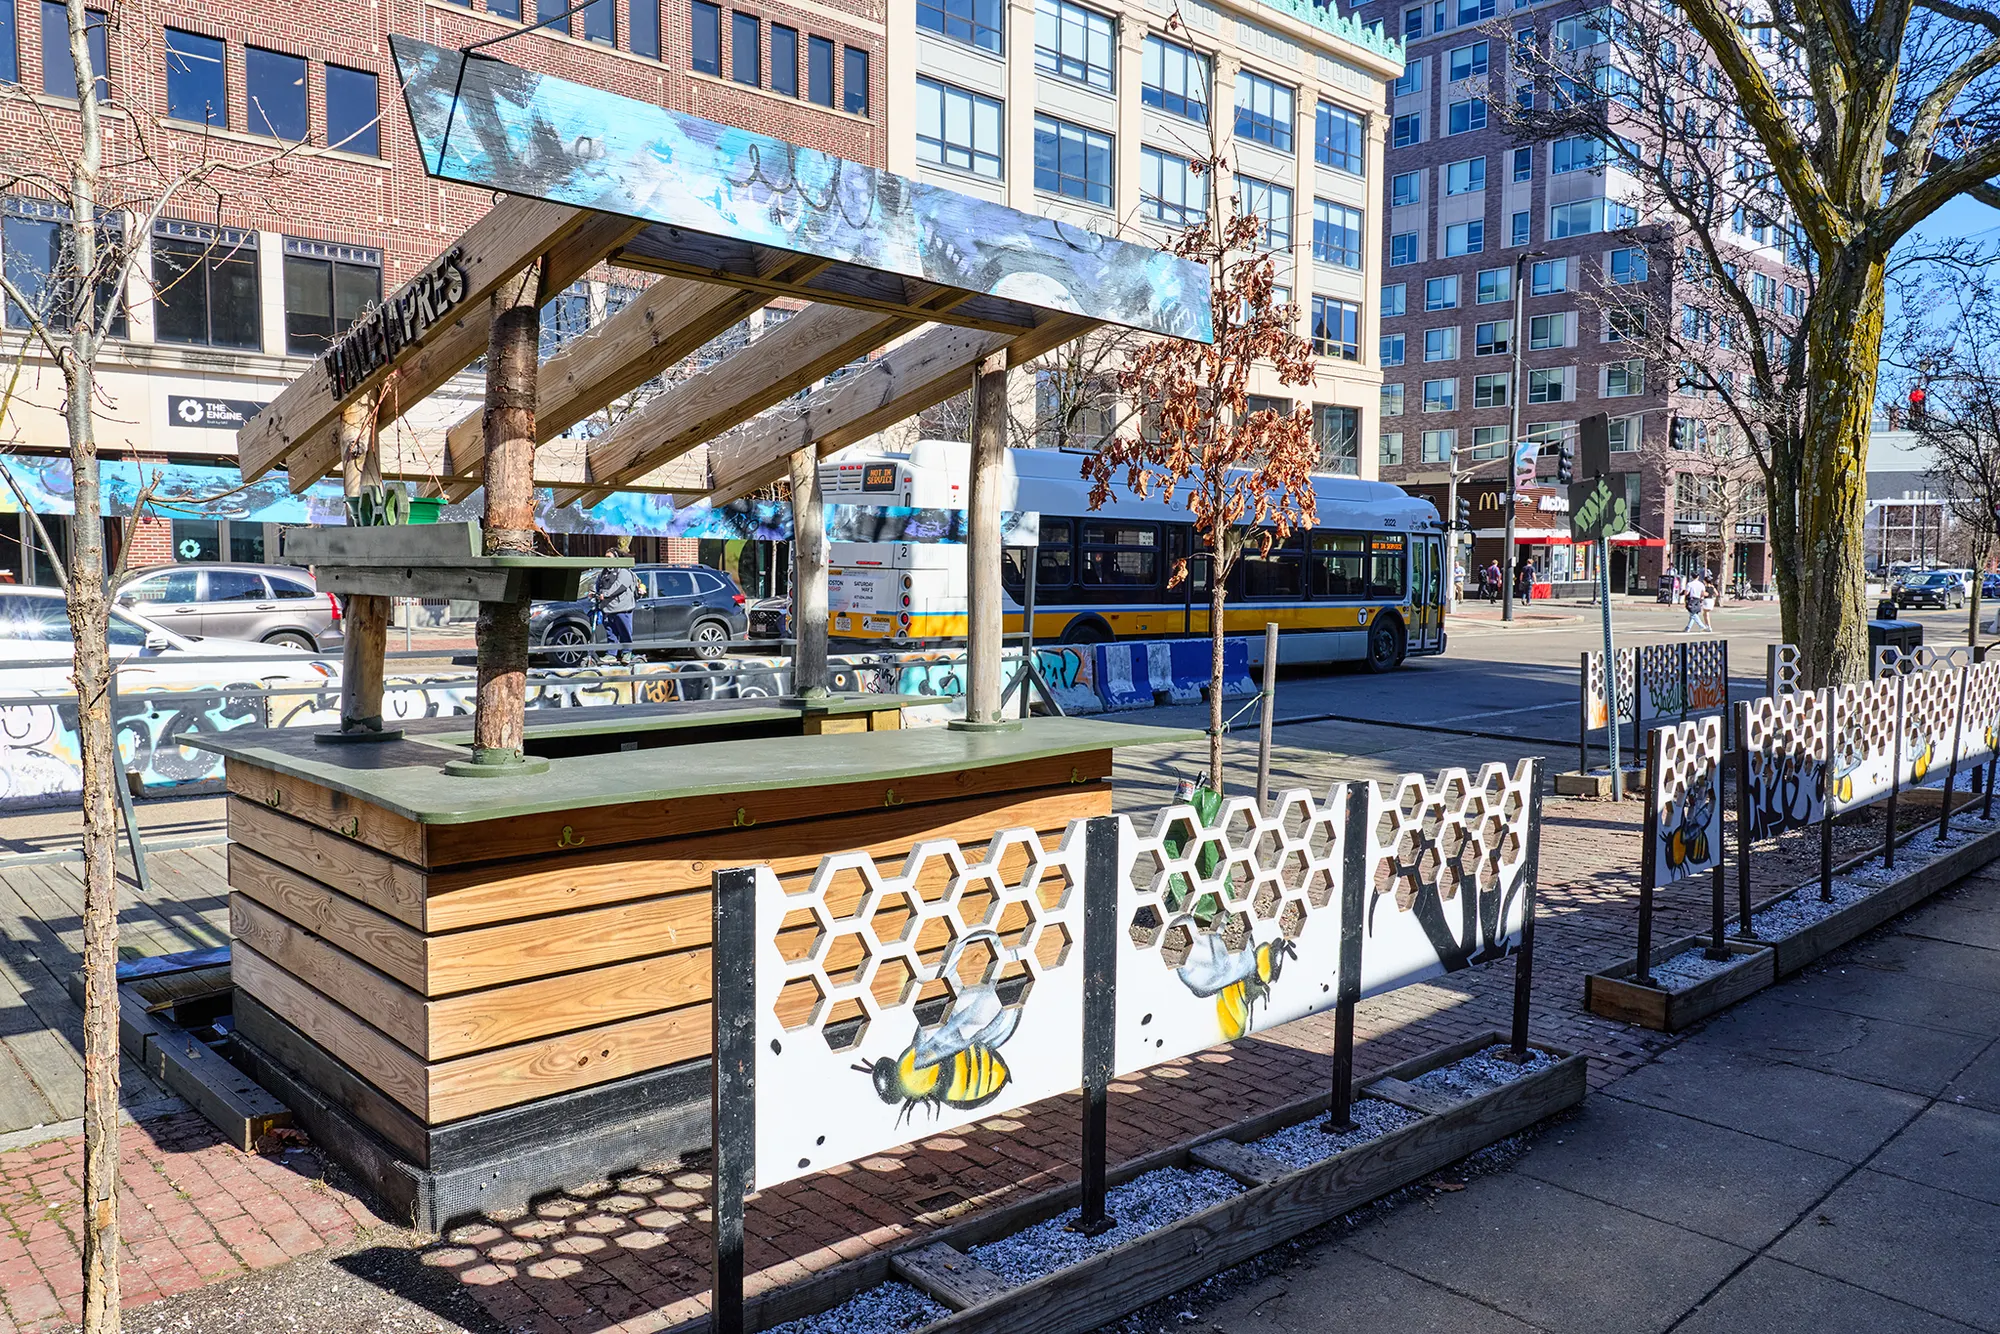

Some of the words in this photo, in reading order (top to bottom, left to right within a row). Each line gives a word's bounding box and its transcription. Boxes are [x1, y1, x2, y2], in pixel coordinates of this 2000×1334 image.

[205, 402, 226, 412] THE
[206, 411, 242, 421] ENGINE
[870, 469, 882, 477] NOT
[867, 475, 893, 485] SERVICE
[1384, 518, 1396, 527] 2022
[1386, 543, 1402, 551] SERVICE
